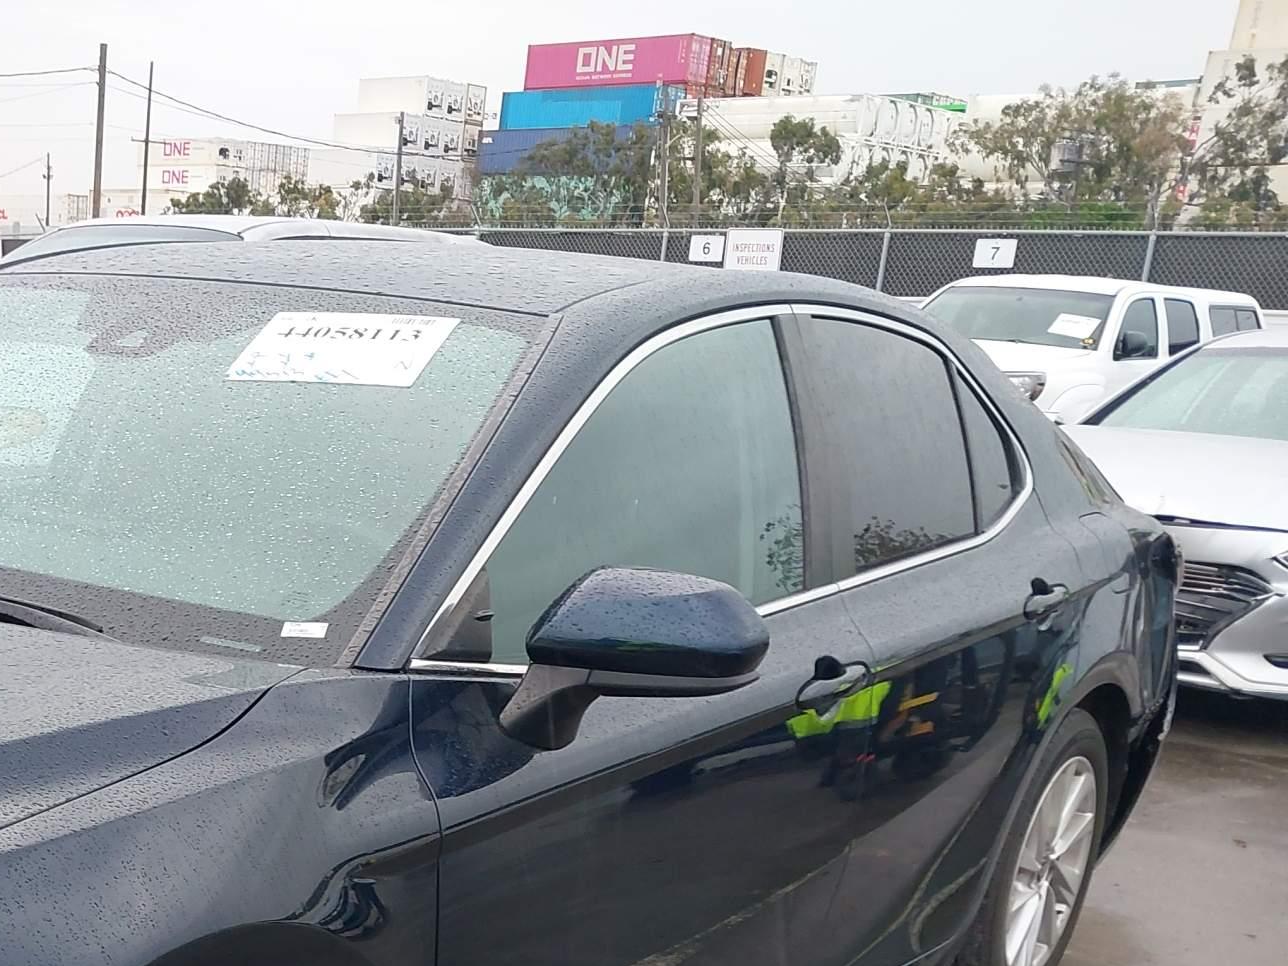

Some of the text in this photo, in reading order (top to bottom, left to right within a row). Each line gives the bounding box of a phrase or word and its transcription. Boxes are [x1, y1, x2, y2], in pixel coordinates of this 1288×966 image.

[576, 44, 635, 72] ONE
[163, 142, 190, 156] ONE
[162, 170, 189, 184] ONE
[702, 241, 711, 255] 6
[732, 242, 775, 253] INSPECTIONS
[991, 246, 1001, 261] 7
[736, 255, 768, 266] VEHICLES
[278, 326, 423, 342] 44058113
